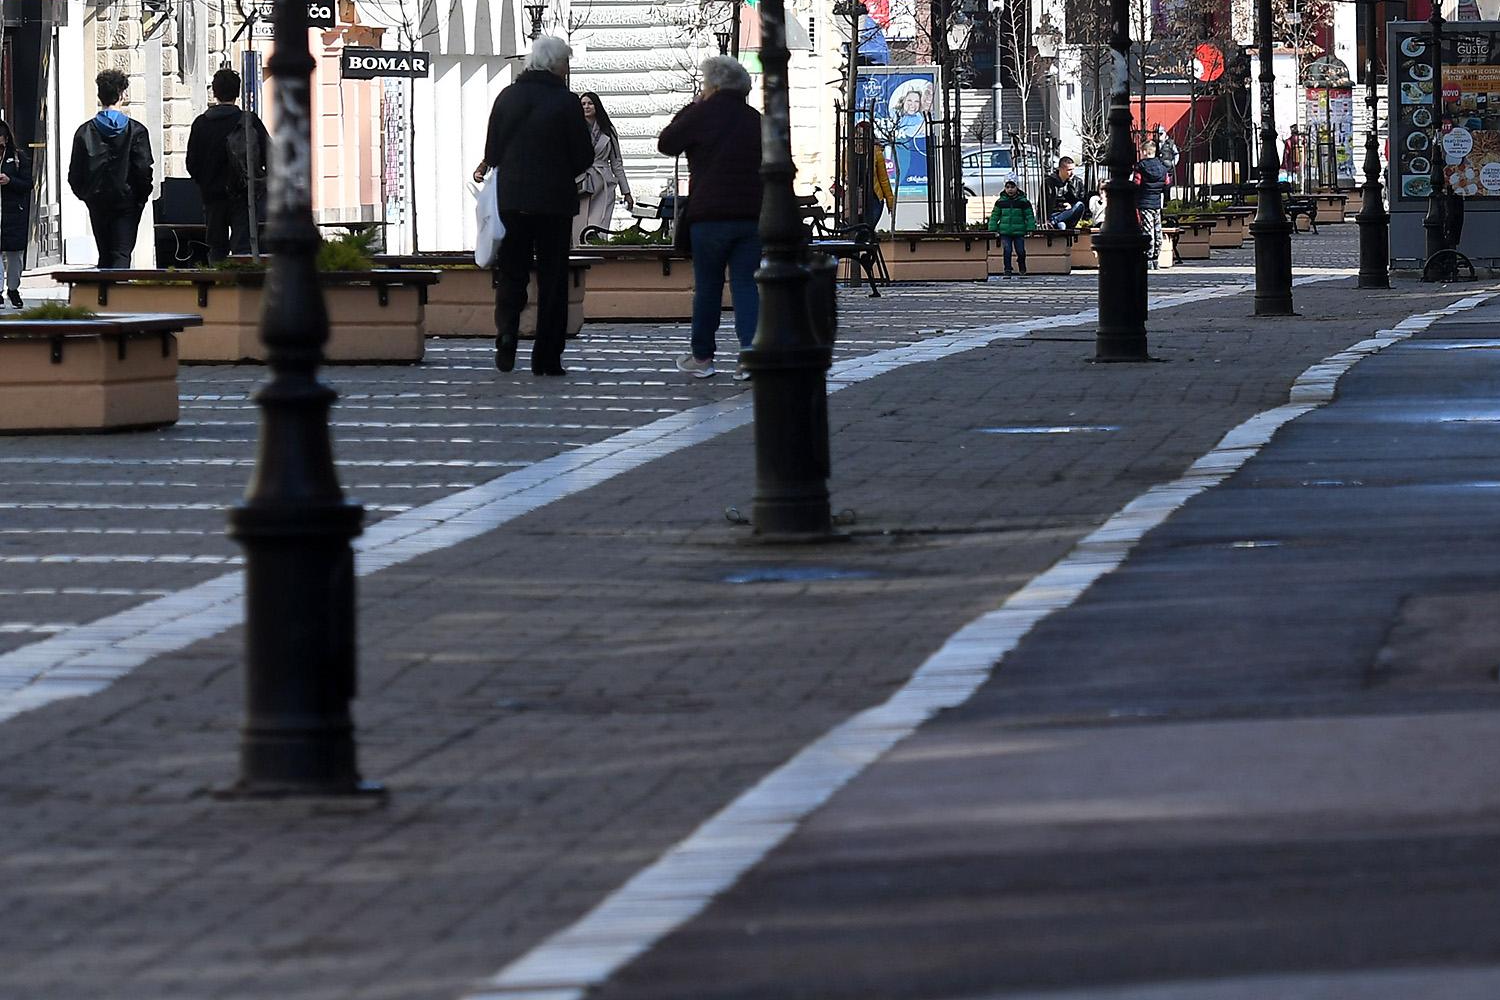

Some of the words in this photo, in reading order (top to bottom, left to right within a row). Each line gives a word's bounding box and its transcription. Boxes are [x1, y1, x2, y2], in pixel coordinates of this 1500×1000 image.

[1457, 45, 1489, 55] GUSTO
[348, 56, 426, 72] BOMAR
[1442, 89, 1459, 97] NOVO
